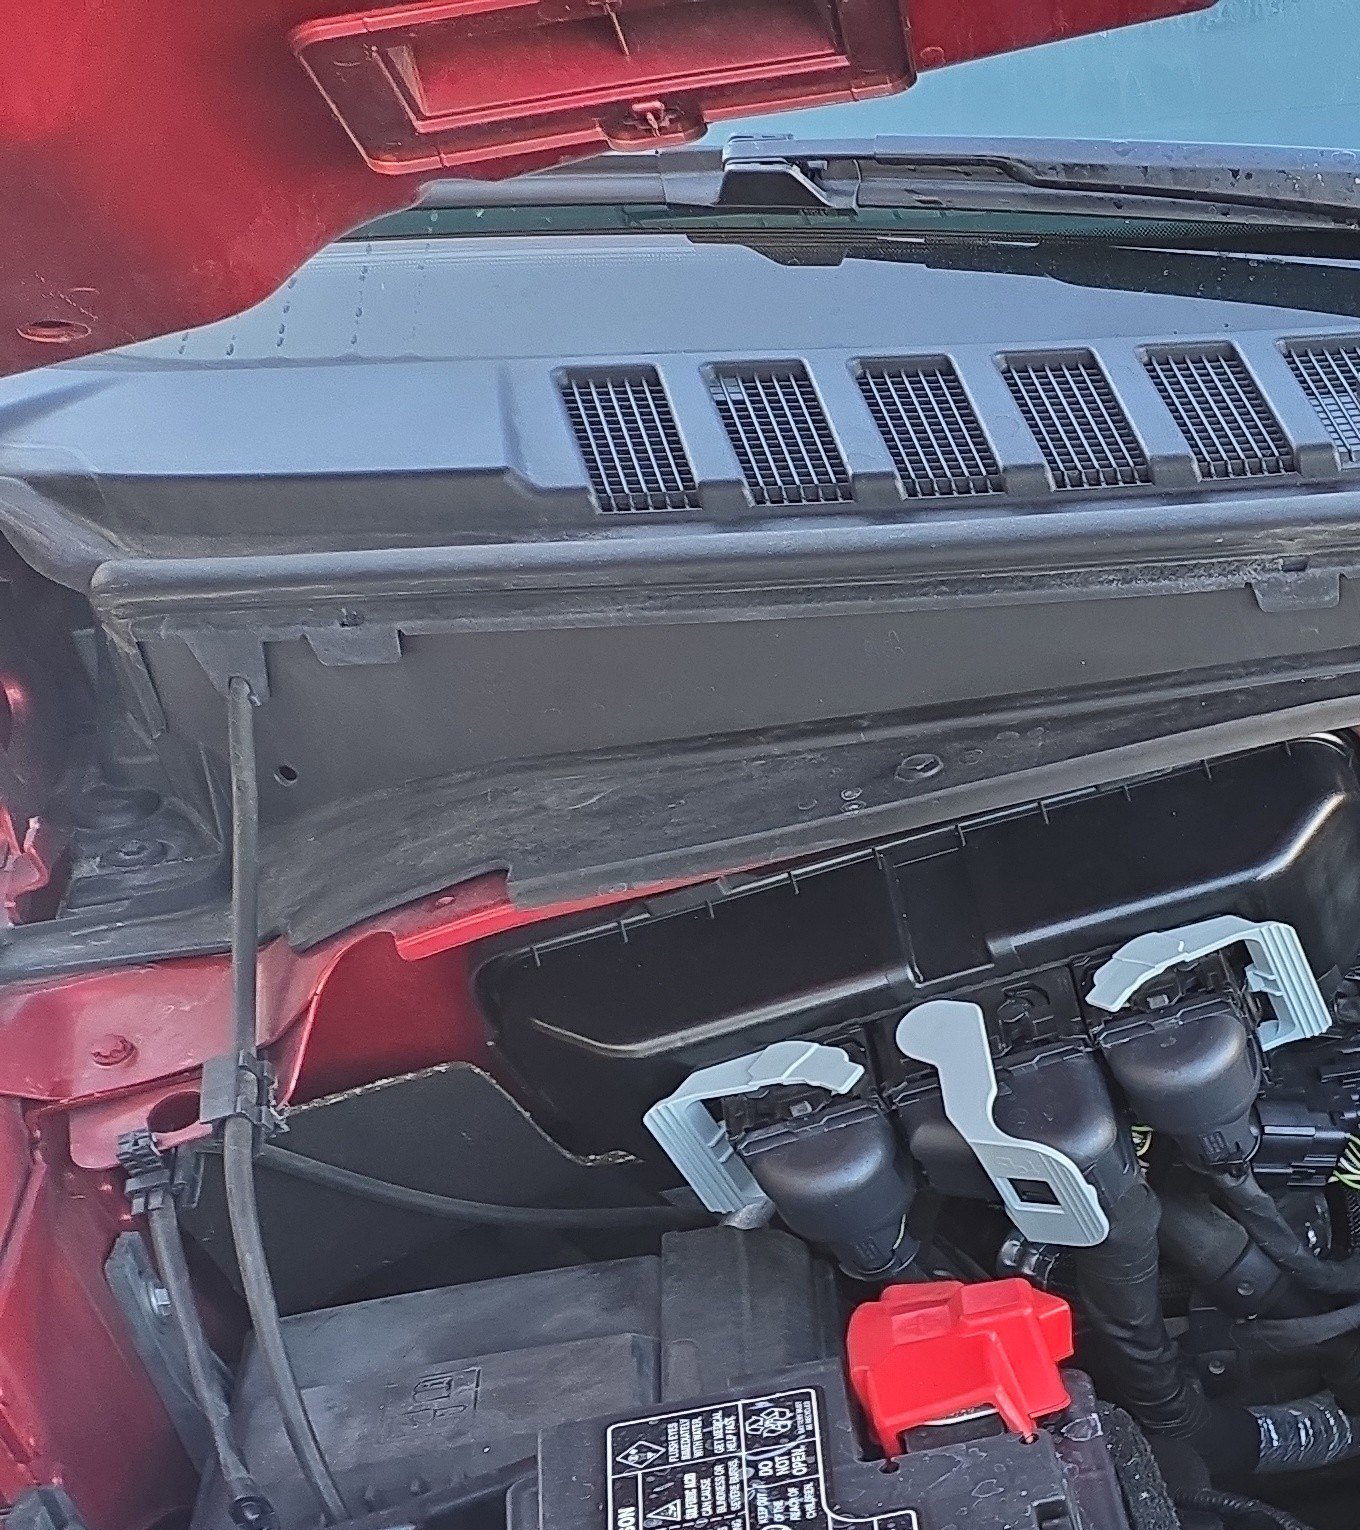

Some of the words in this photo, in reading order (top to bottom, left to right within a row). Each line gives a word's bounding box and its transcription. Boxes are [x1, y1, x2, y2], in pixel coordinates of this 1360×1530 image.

[668, 1423, 678, 1440] EYES
[712, 1410, 724, 1439] MEDICAL
[668, 1440, 679, 1462] FLUSH
[693, 1440, 703, 1458] WITH
[714, 1440, 724, 1453] GET
[726, 1435, 737, 1452] HELP
[758, 1461, 773, 1476] DO
[775, 1455, 790, 1476] NOT
[791, 1446, 807, 1475] OPEN.
[714, 1464, 724, 1475] OR
[684, 1473, 696, 1488] ACID
[700, 1478, 712, 1501] CAUSE
[715, 1476, 727, 1514] BLINDNESS
[730, 1484, 741, 1510] SEVERE
[788, 1488, 798, 1497] OF
[757, 1493, 768, 1506] OUT
[773, 1500, 784, 1512] THE
[702, 1501, 713, 1516] CAN
[757, 1507, 768, 1524] KEEP
[774, 1513, 785, 1521] OF
[789, 1498, 801, 1520] REACH
